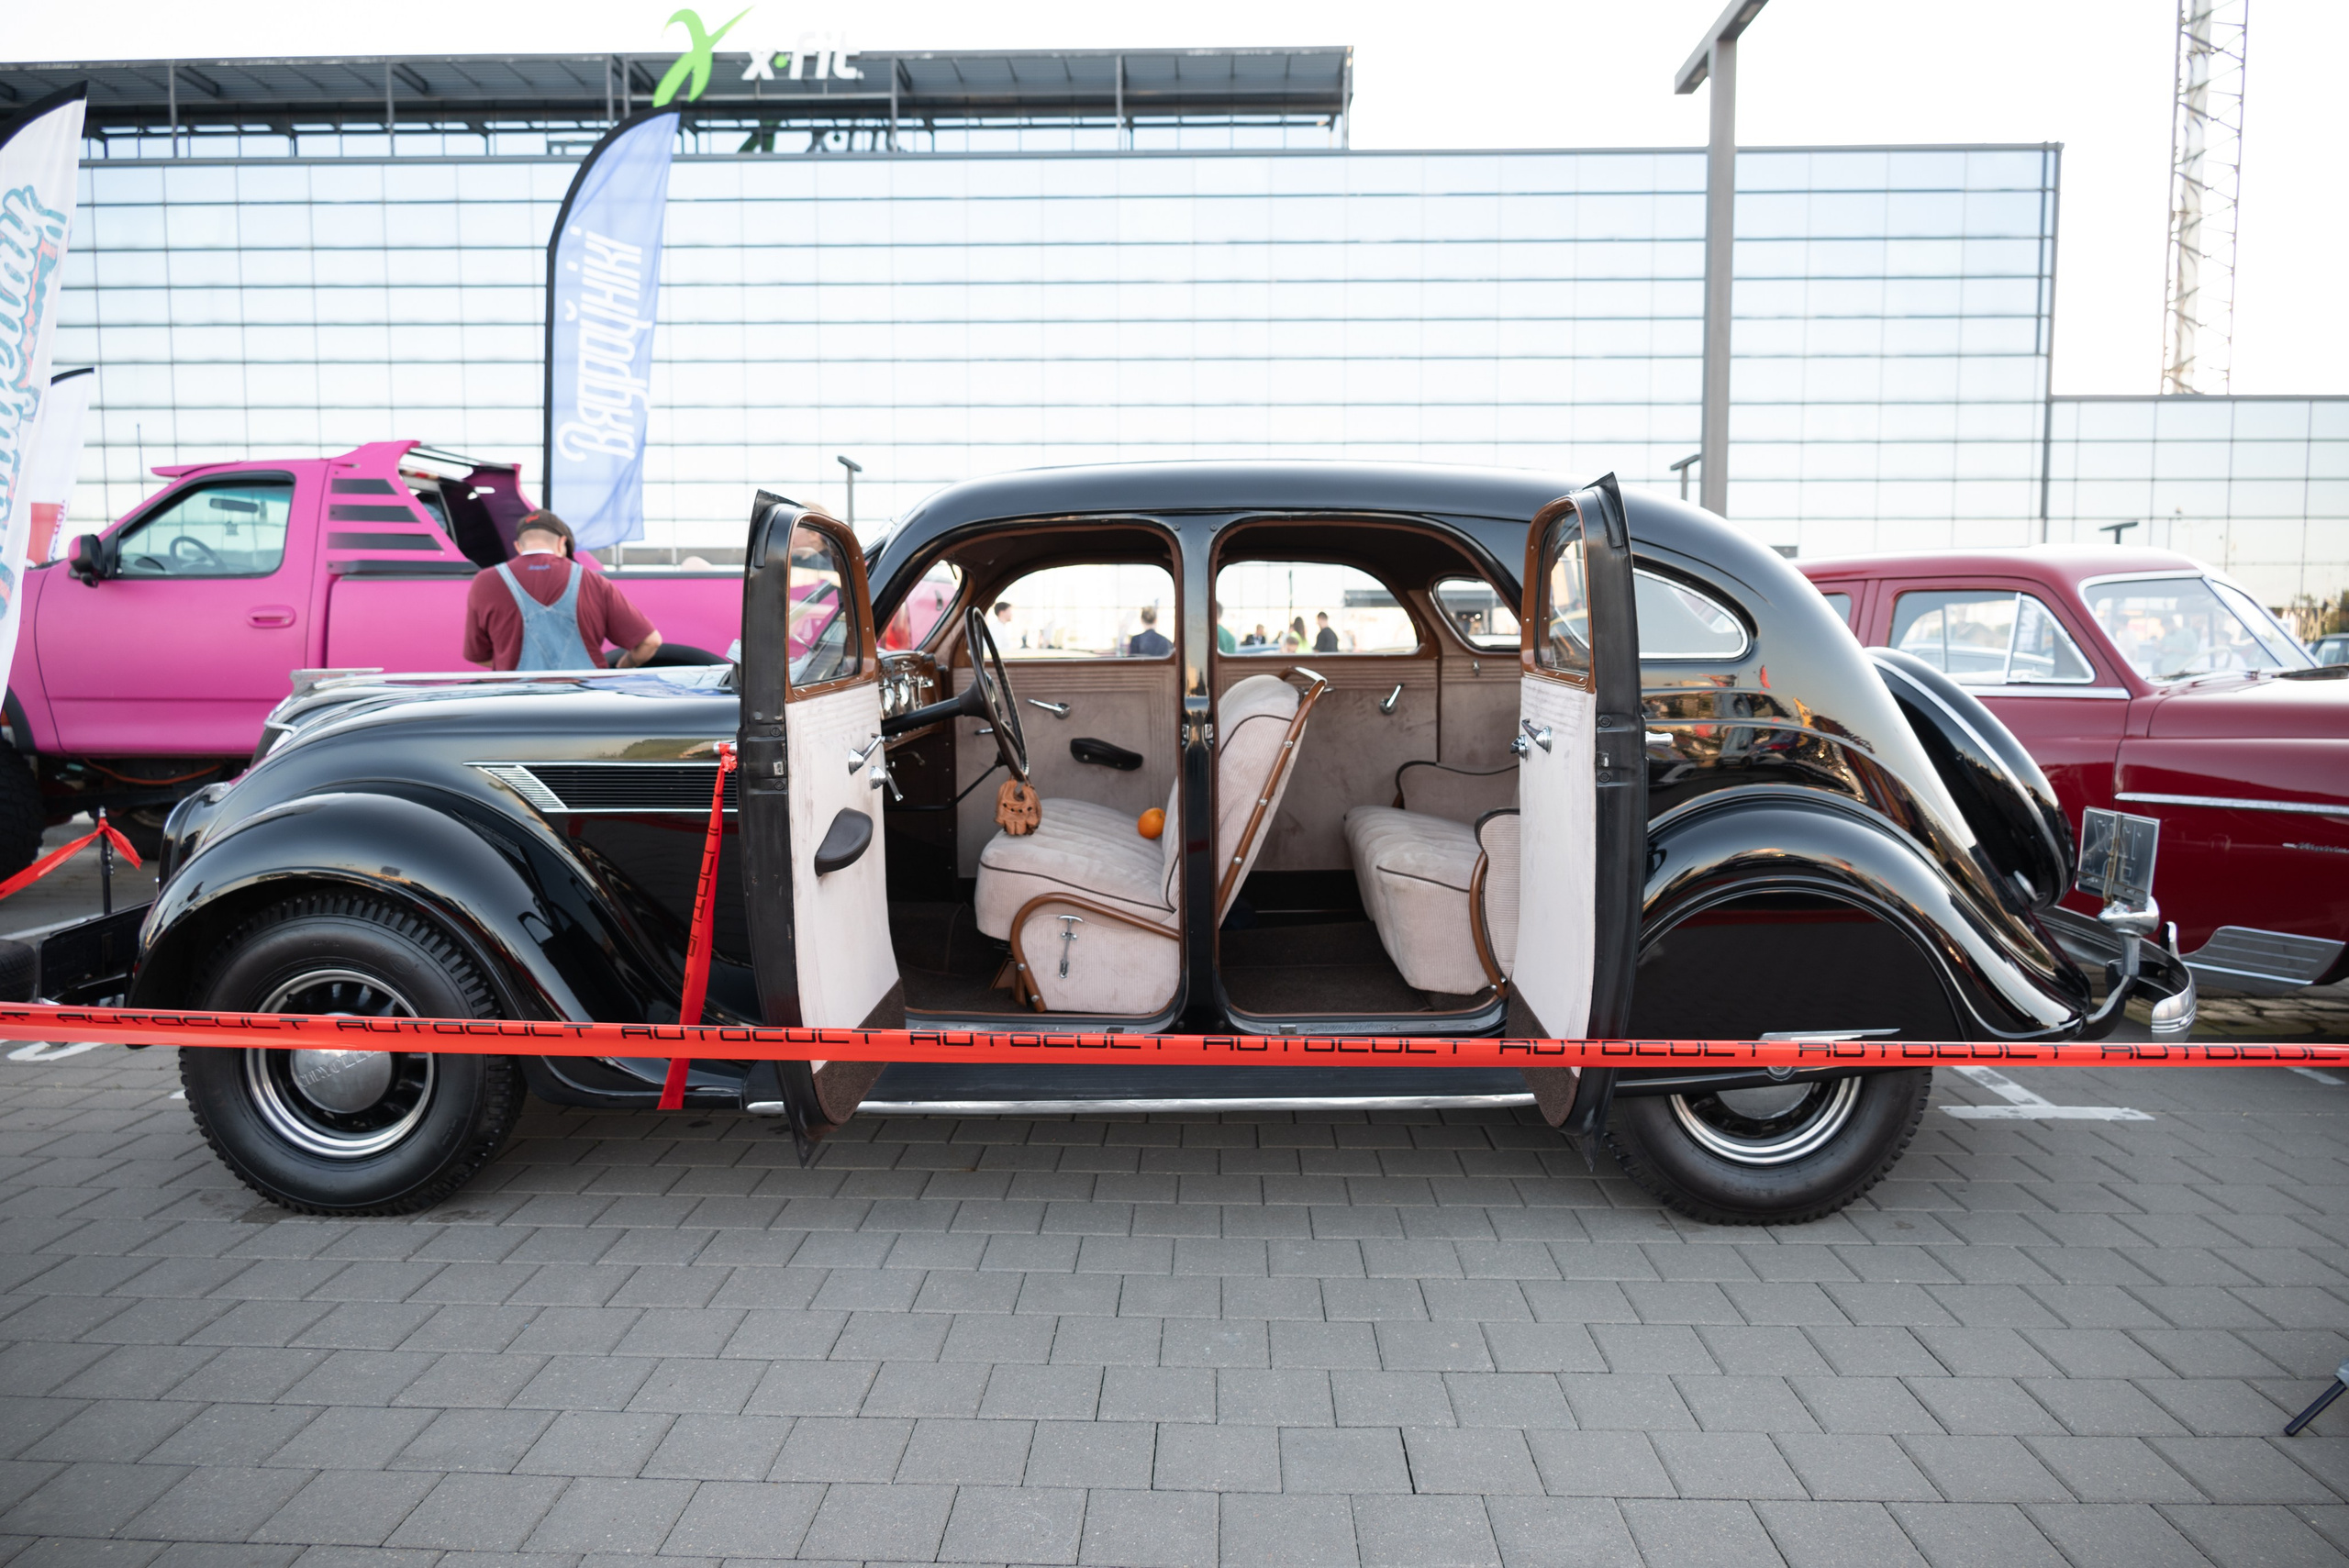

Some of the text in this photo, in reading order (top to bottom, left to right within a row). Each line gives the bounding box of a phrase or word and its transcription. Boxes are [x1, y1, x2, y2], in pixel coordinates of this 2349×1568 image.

[57, 1012, 309, 1030] AUTOCULT
[336, 1019, 594, 1038] AUTOCULT
[621, 1026, 882, 1044] AUTOCULT
[910, 1031, 1174, 1050] AUTOCULT
[1203, 1037, 1471, 1055] AUTOCULT
[1499, 1040, 1769, 1058] AUTOCULT
[1798, 1042, 2070, 1060] AUTOCULT
